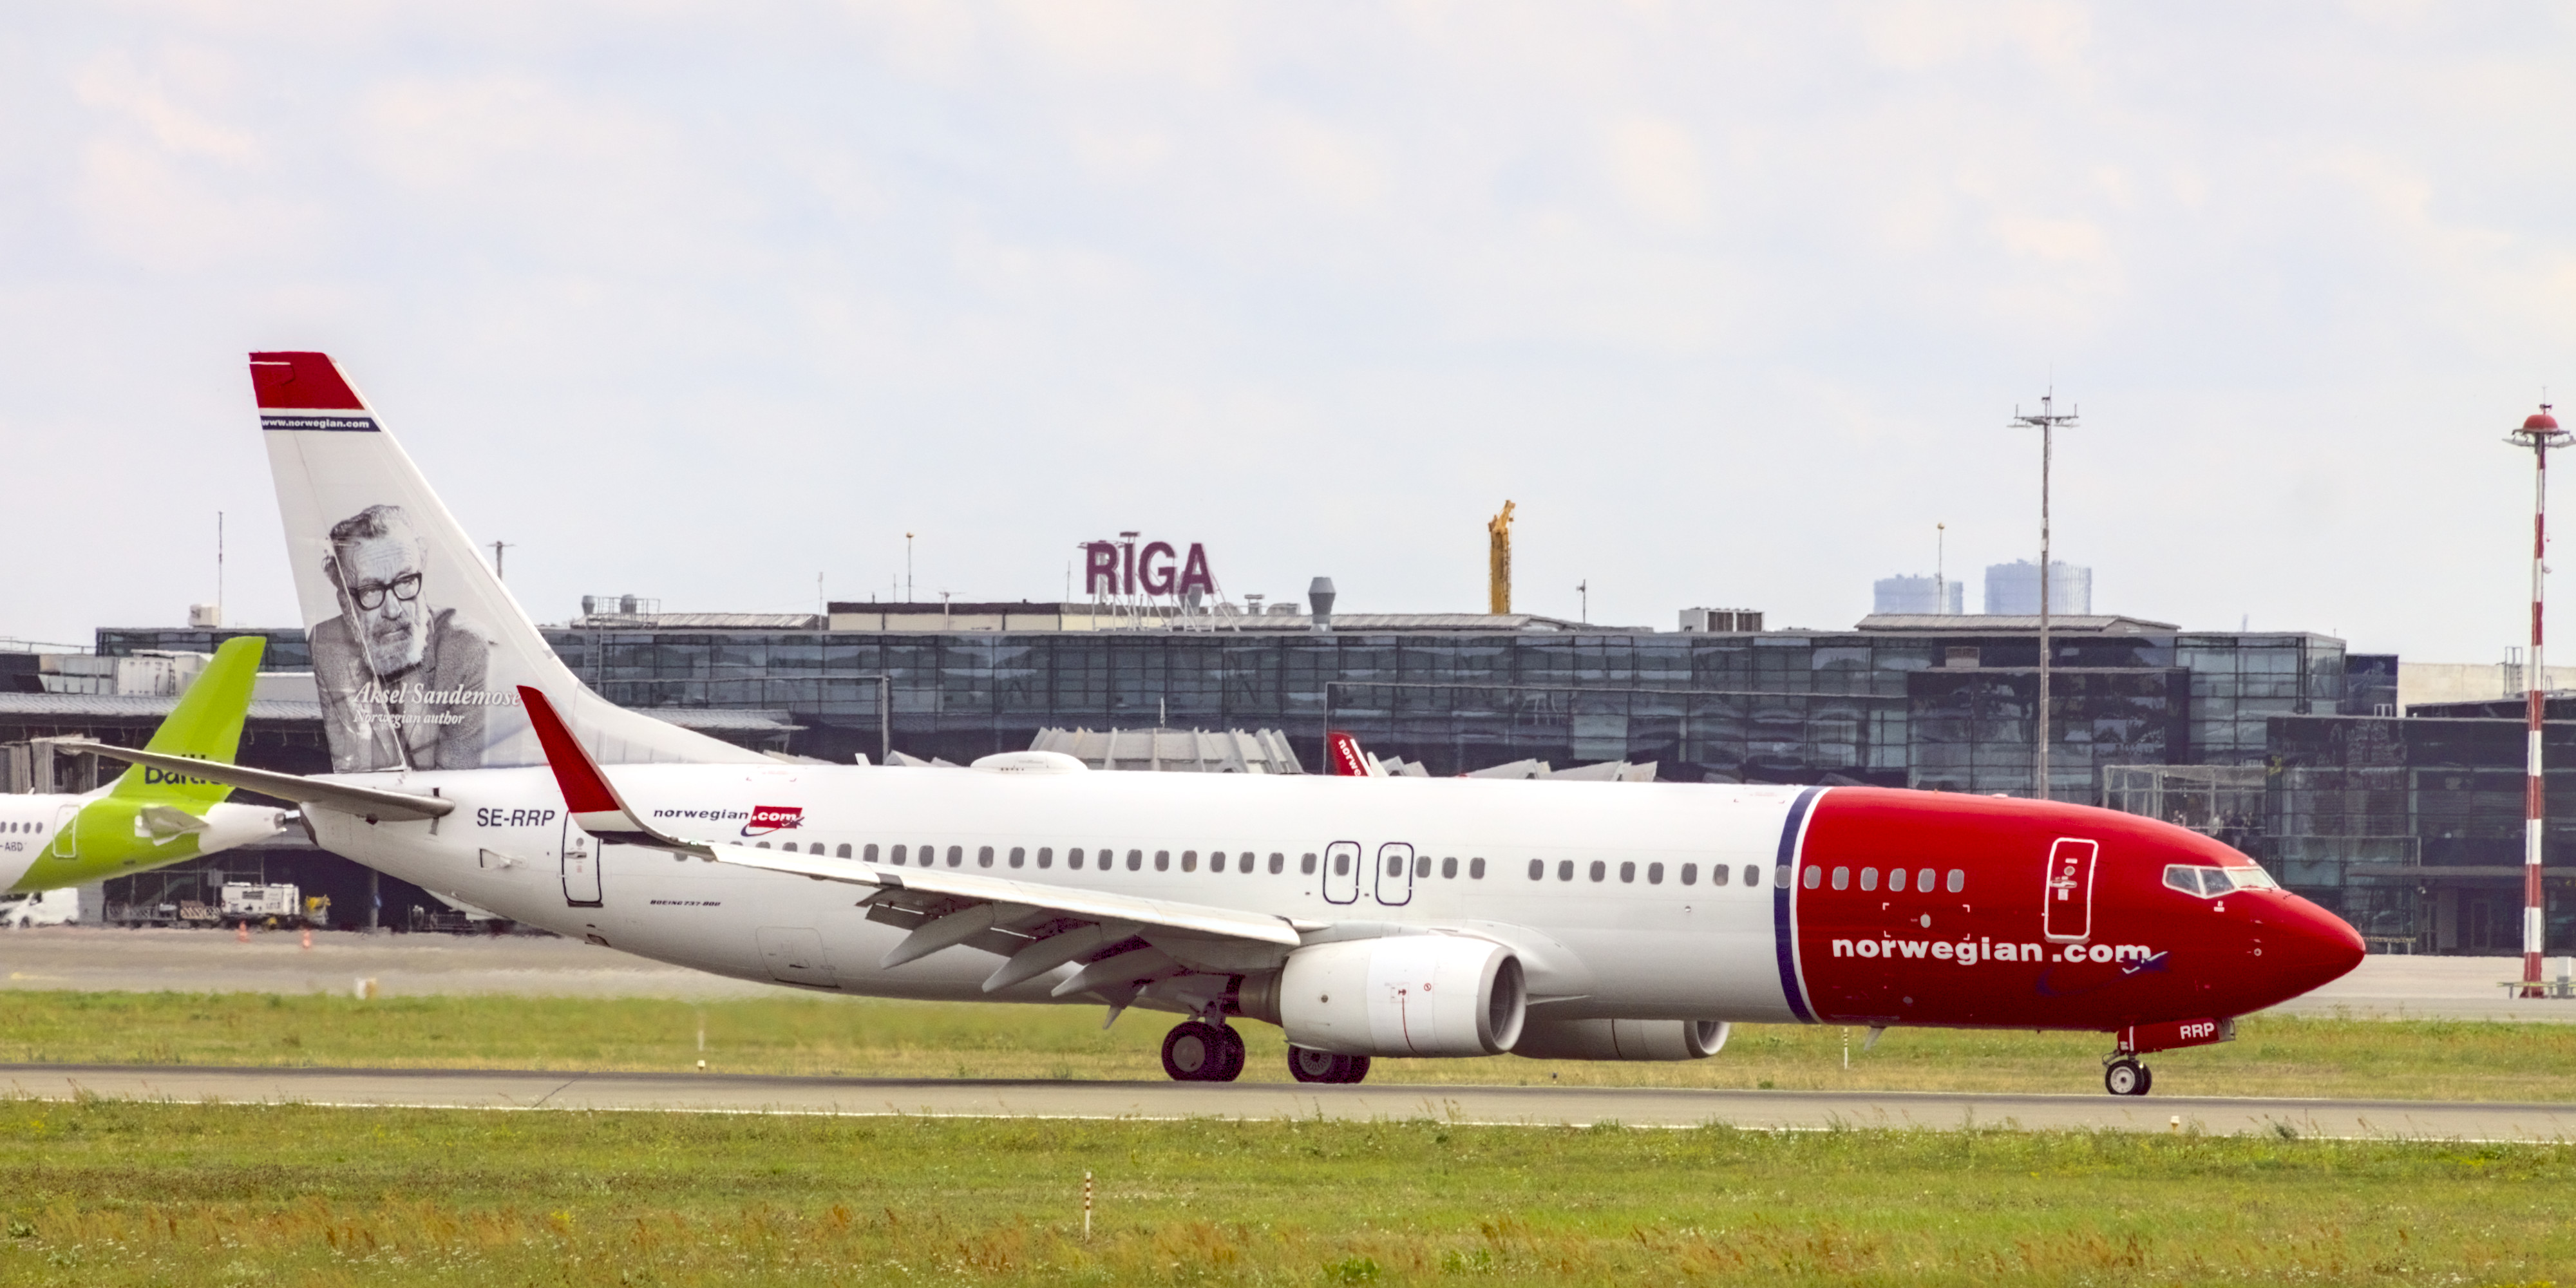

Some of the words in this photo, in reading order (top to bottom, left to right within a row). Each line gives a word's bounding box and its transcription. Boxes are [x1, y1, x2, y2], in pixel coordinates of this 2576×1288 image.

[262, 419, 370, 429] www.norwegian.com
[353, 681, 407, 705] Aksel
[412, 682, 521, 706] Sandemose
[353, 710, 421, 729] Norwegian
[423, 710, 465, 725] author
[477, 807, 555, 827] SE-RRP
[2179, 1022, 2215, 1039] RRP
